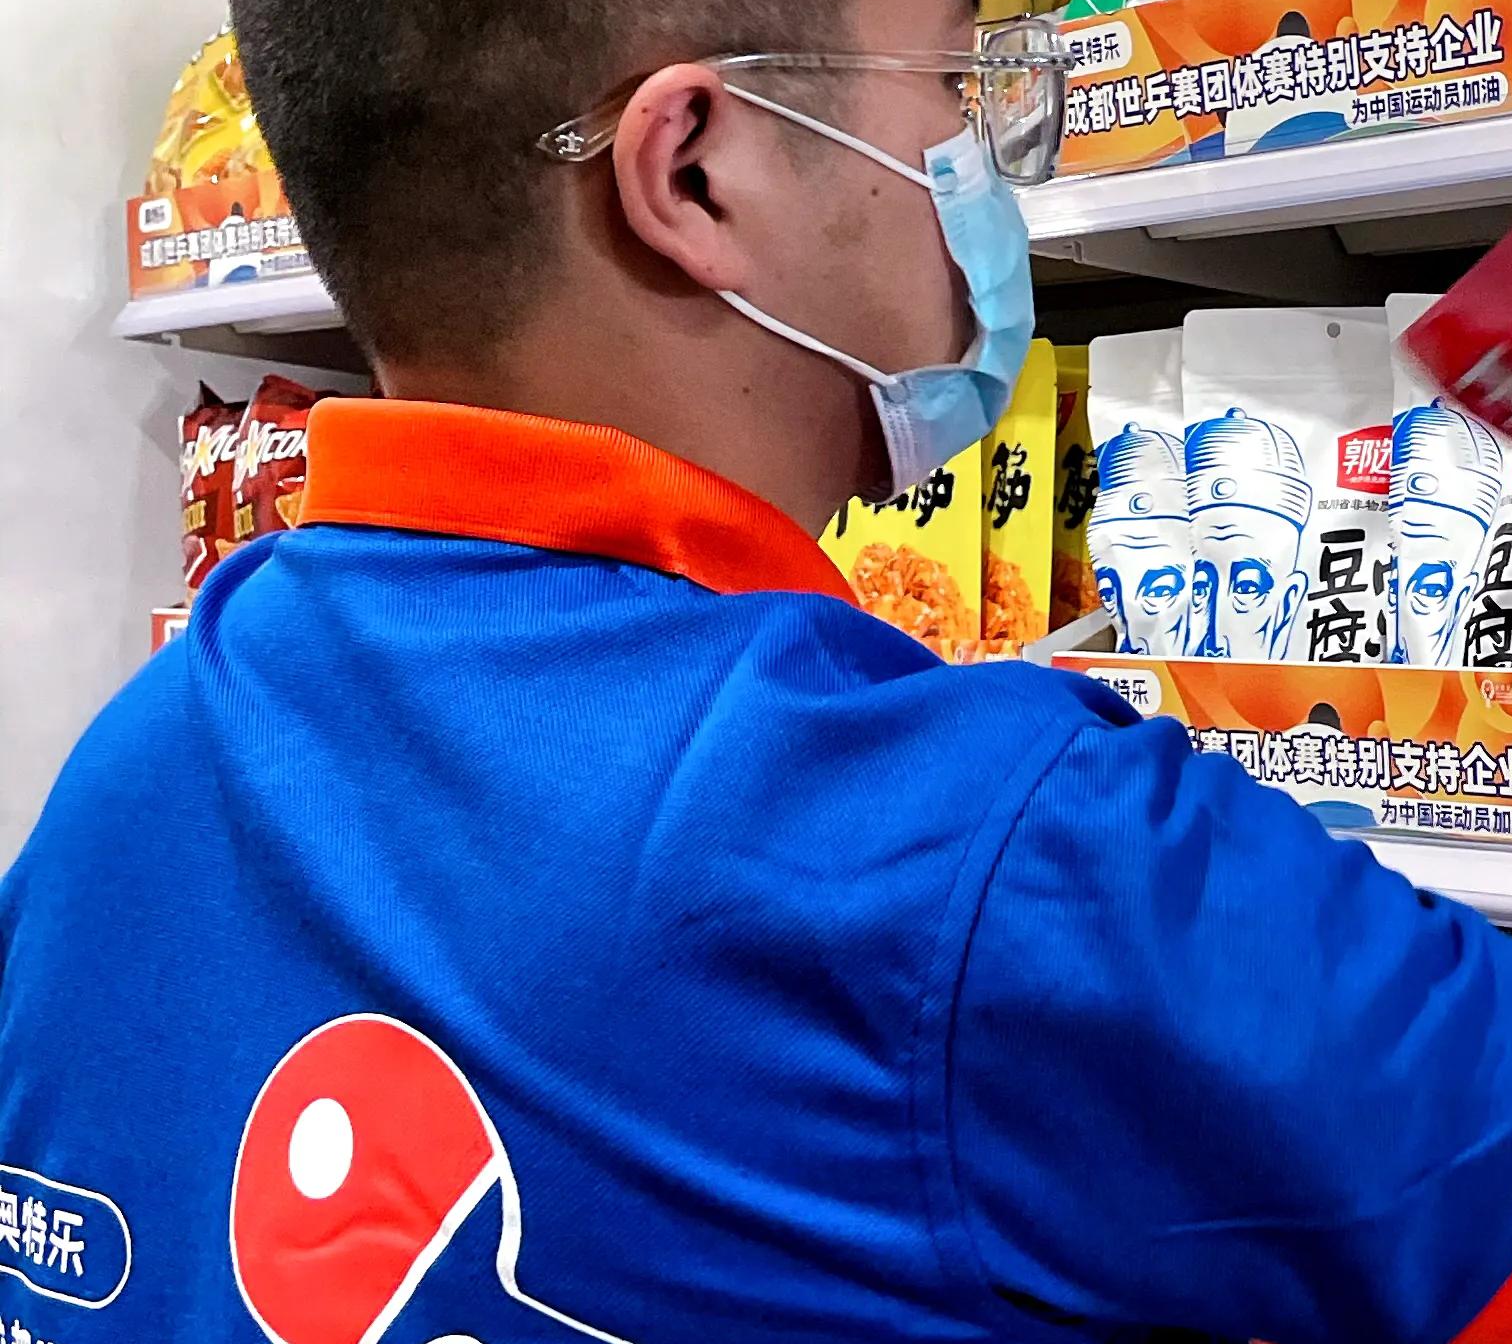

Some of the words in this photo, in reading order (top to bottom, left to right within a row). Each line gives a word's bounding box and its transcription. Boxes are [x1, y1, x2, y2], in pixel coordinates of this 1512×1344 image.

[1064, 10, 1503, 137] 成都世乒赛团体赛特别支持企业
[1352, 80, 1501, 124] 为中国运动员加油
